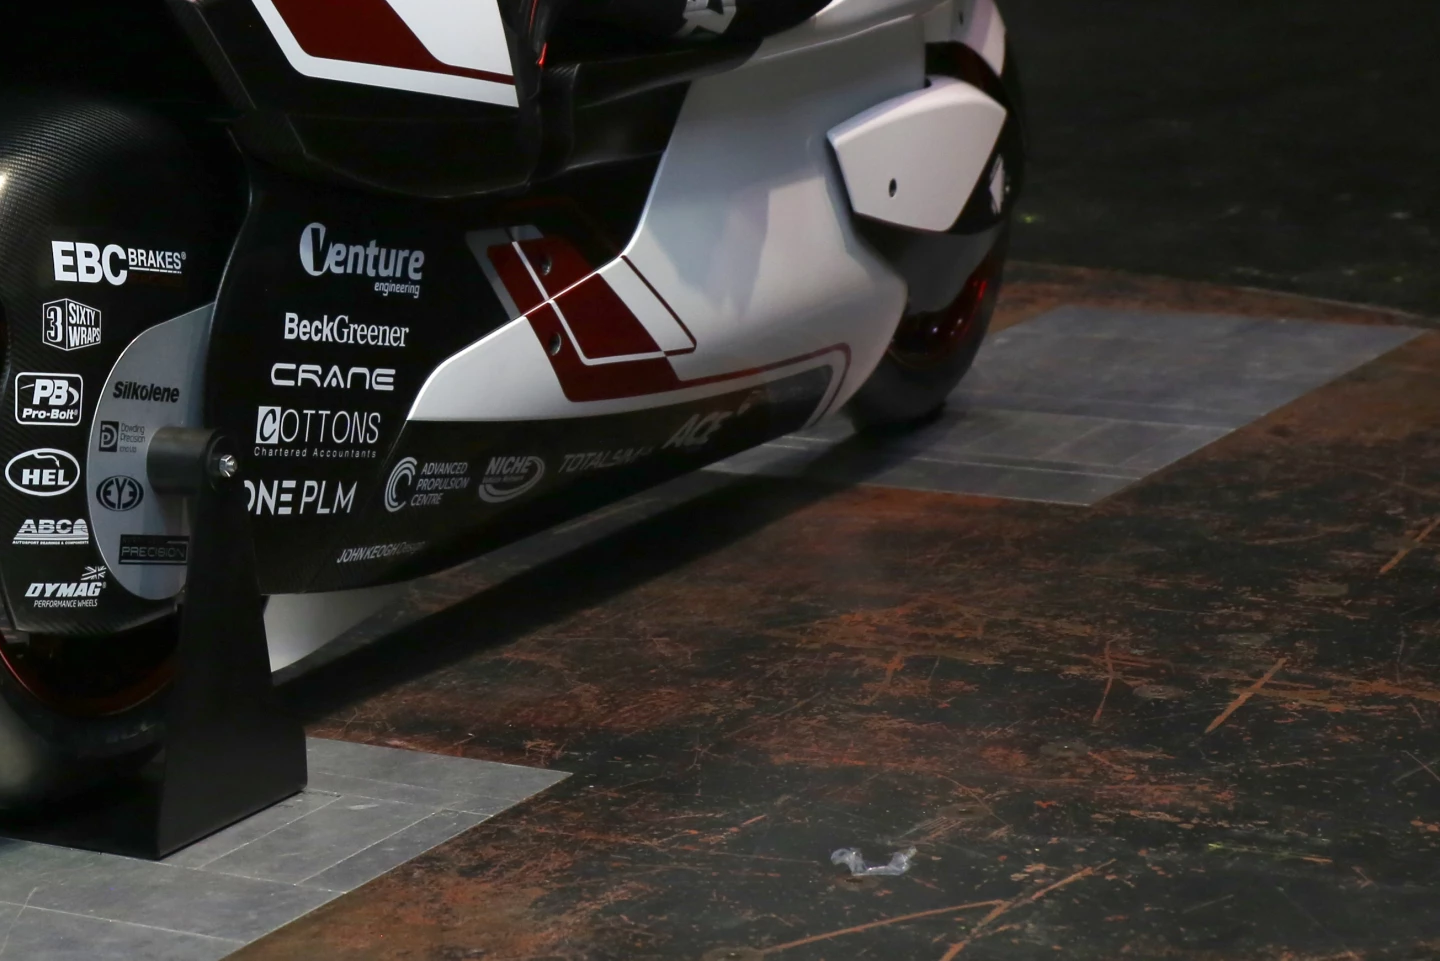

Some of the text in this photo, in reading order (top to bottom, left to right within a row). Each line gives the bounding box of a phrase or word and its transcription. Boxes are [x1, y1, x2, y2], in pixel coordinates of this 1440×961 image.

[51, 240, 128, 286] EBC
[374, 280, 420, 298] engineering
[46, 306, 63, 343] 3
[68, 303, 96, 326] SIXTY
[68, 325, 101, 348] WRAPS
[284, 312, 409, 347] BeckGreener
[271, 362, 396, 391] CRANE
[32, 379, 70, 406] PB
[113, 380, 180, 404] Silkolene
[257, 406, 381, 444] COTTONS
[254, 446, 377, 459] Chartered Accountants
[420, 462, 468, 476] ADVANCED
[484, 456, 532, 475] NICHE
[21, 468, 70, 486] HEL
[416, 477, 471, 491] PROPULSION
[299, 480, 358, 515] PLM
[410, 493, 443, 507] CENTRE
[121, 546, 185, 558] PRECISION
[24, 581, 103, 598] DYMAG
[34, 598, 98, 608] PERFORMANCE WHEELS
